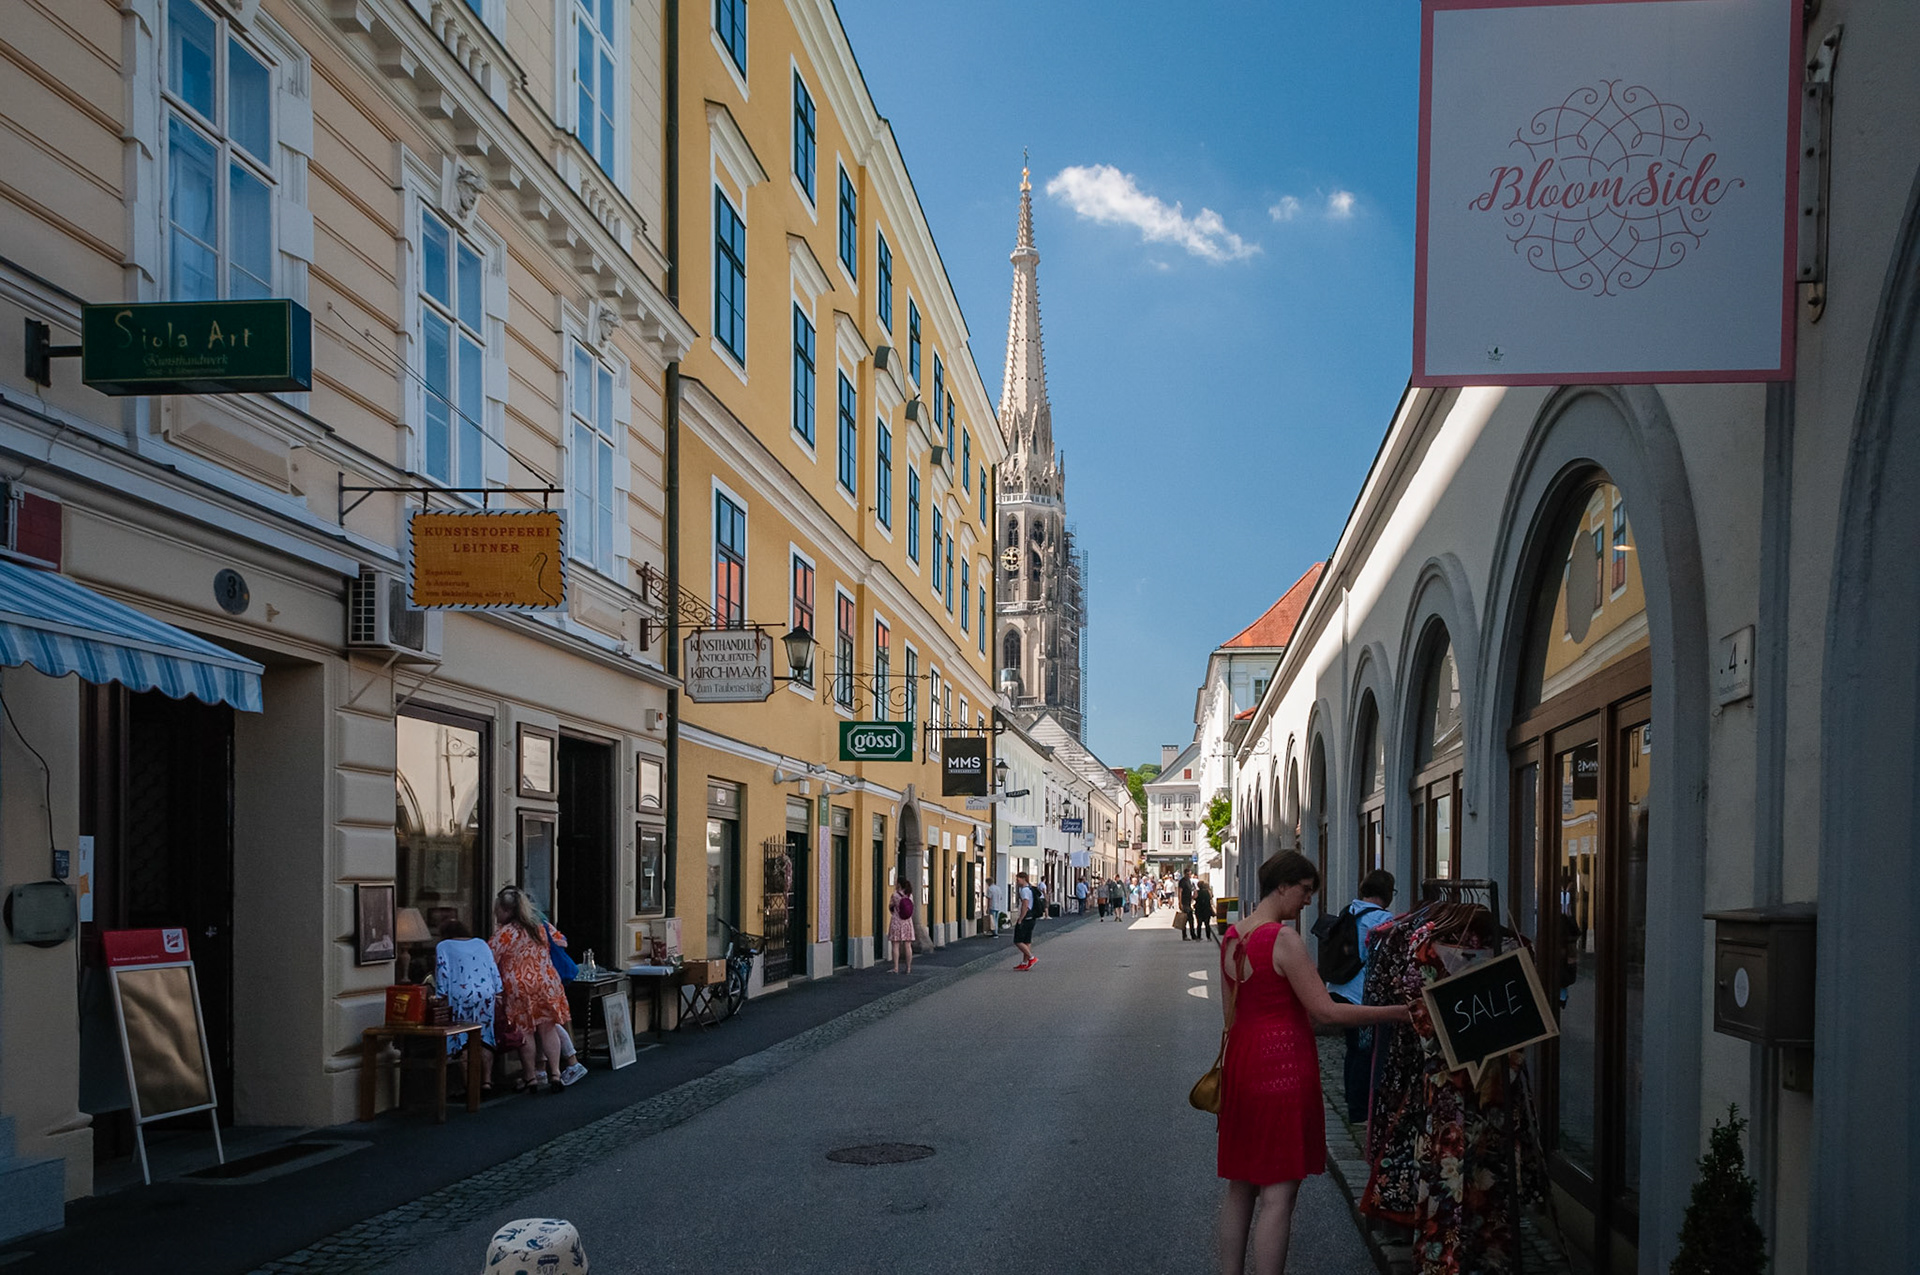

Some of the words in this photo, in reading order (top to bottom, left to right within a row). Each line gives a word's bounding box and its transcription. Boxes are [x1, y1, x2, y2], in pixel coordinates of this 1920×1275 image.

[115, 310, 188, 350] Siola
[207, 320, 253, 349] Art
[424, 527, 551, 537] KUNSTSTOPFEREI
[453, 543, 520, 553] LEITNER
[226, 575, 238, 600] 3
[1728, 642, 1738, 675] 4
[690, 666, 767, 679] KIRCHMAYR
[854, 732, 897, 752] gössl
[948, 756, 981, 769] MMS
[1454, 980, 1523, 1034] SALE
